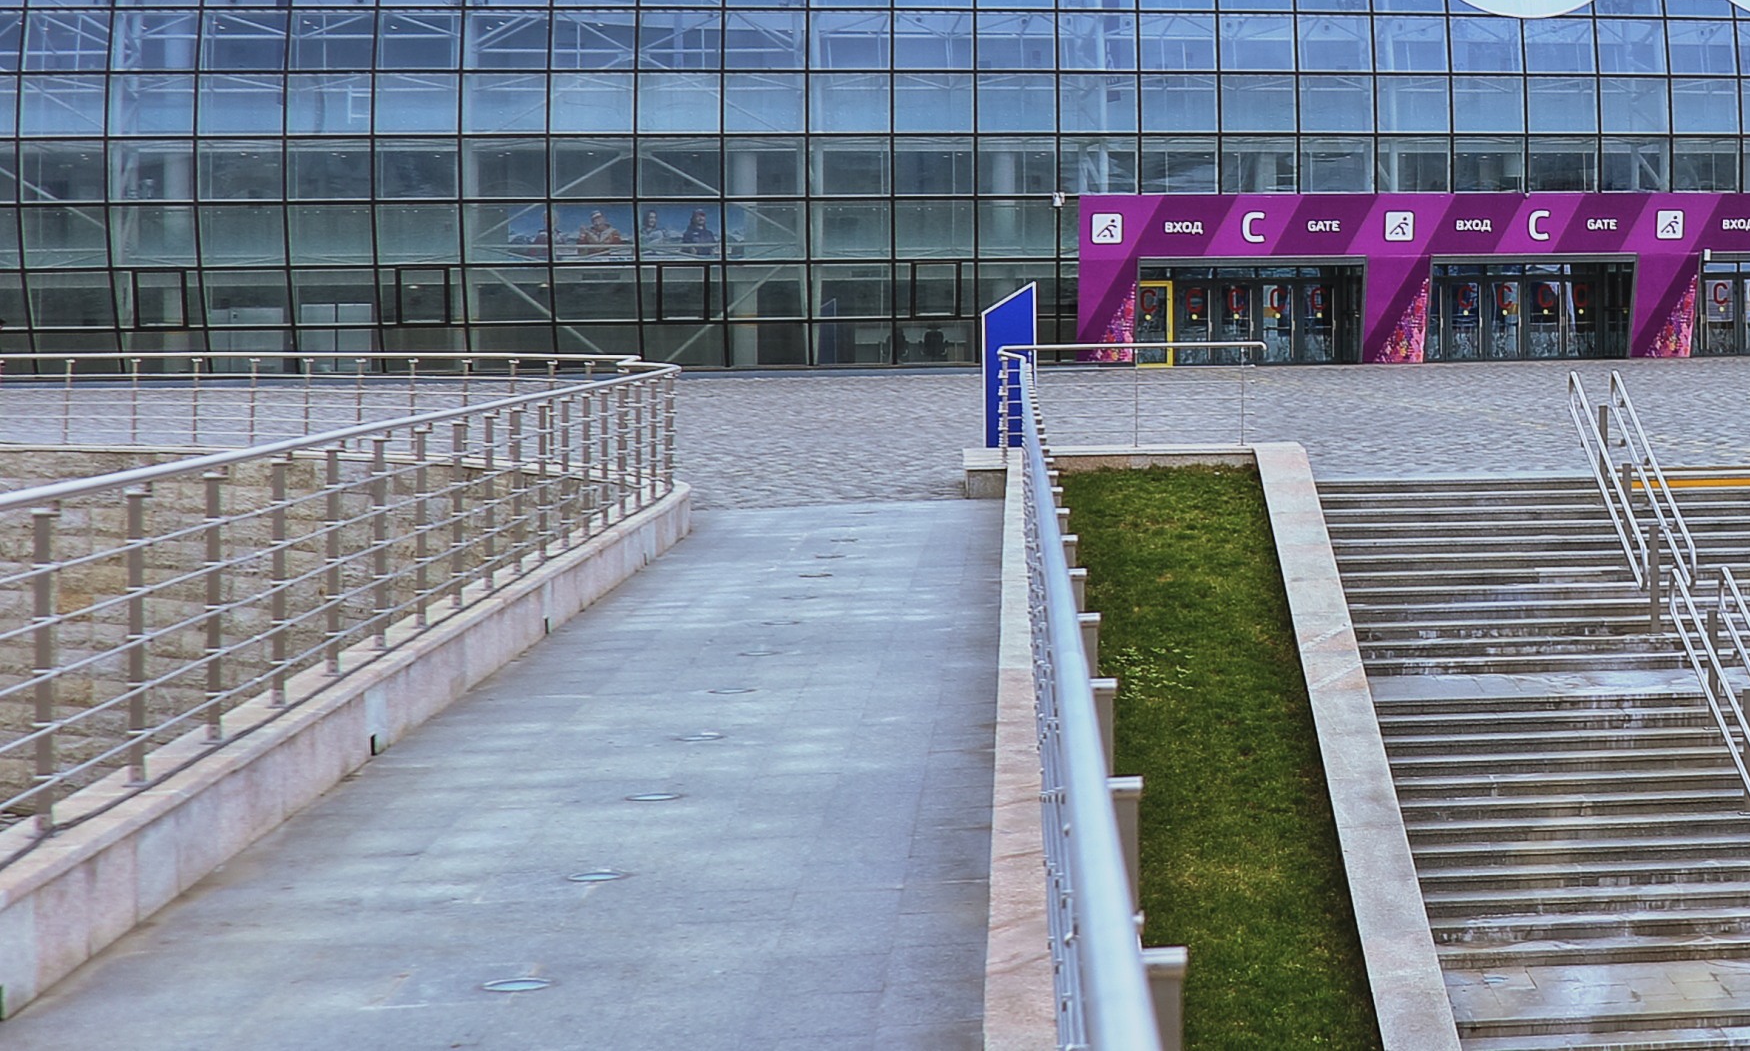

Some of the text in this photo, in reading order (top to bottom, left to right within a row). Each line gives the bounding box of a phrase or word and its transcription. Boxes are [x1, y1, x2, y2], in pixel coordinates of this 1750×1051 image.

[1164, 211, 1341, 243] ВХОД C GATE
[1455, 210, 1618, 241] ВХОД C GATE
[1713, 282, 1728, 305] C
